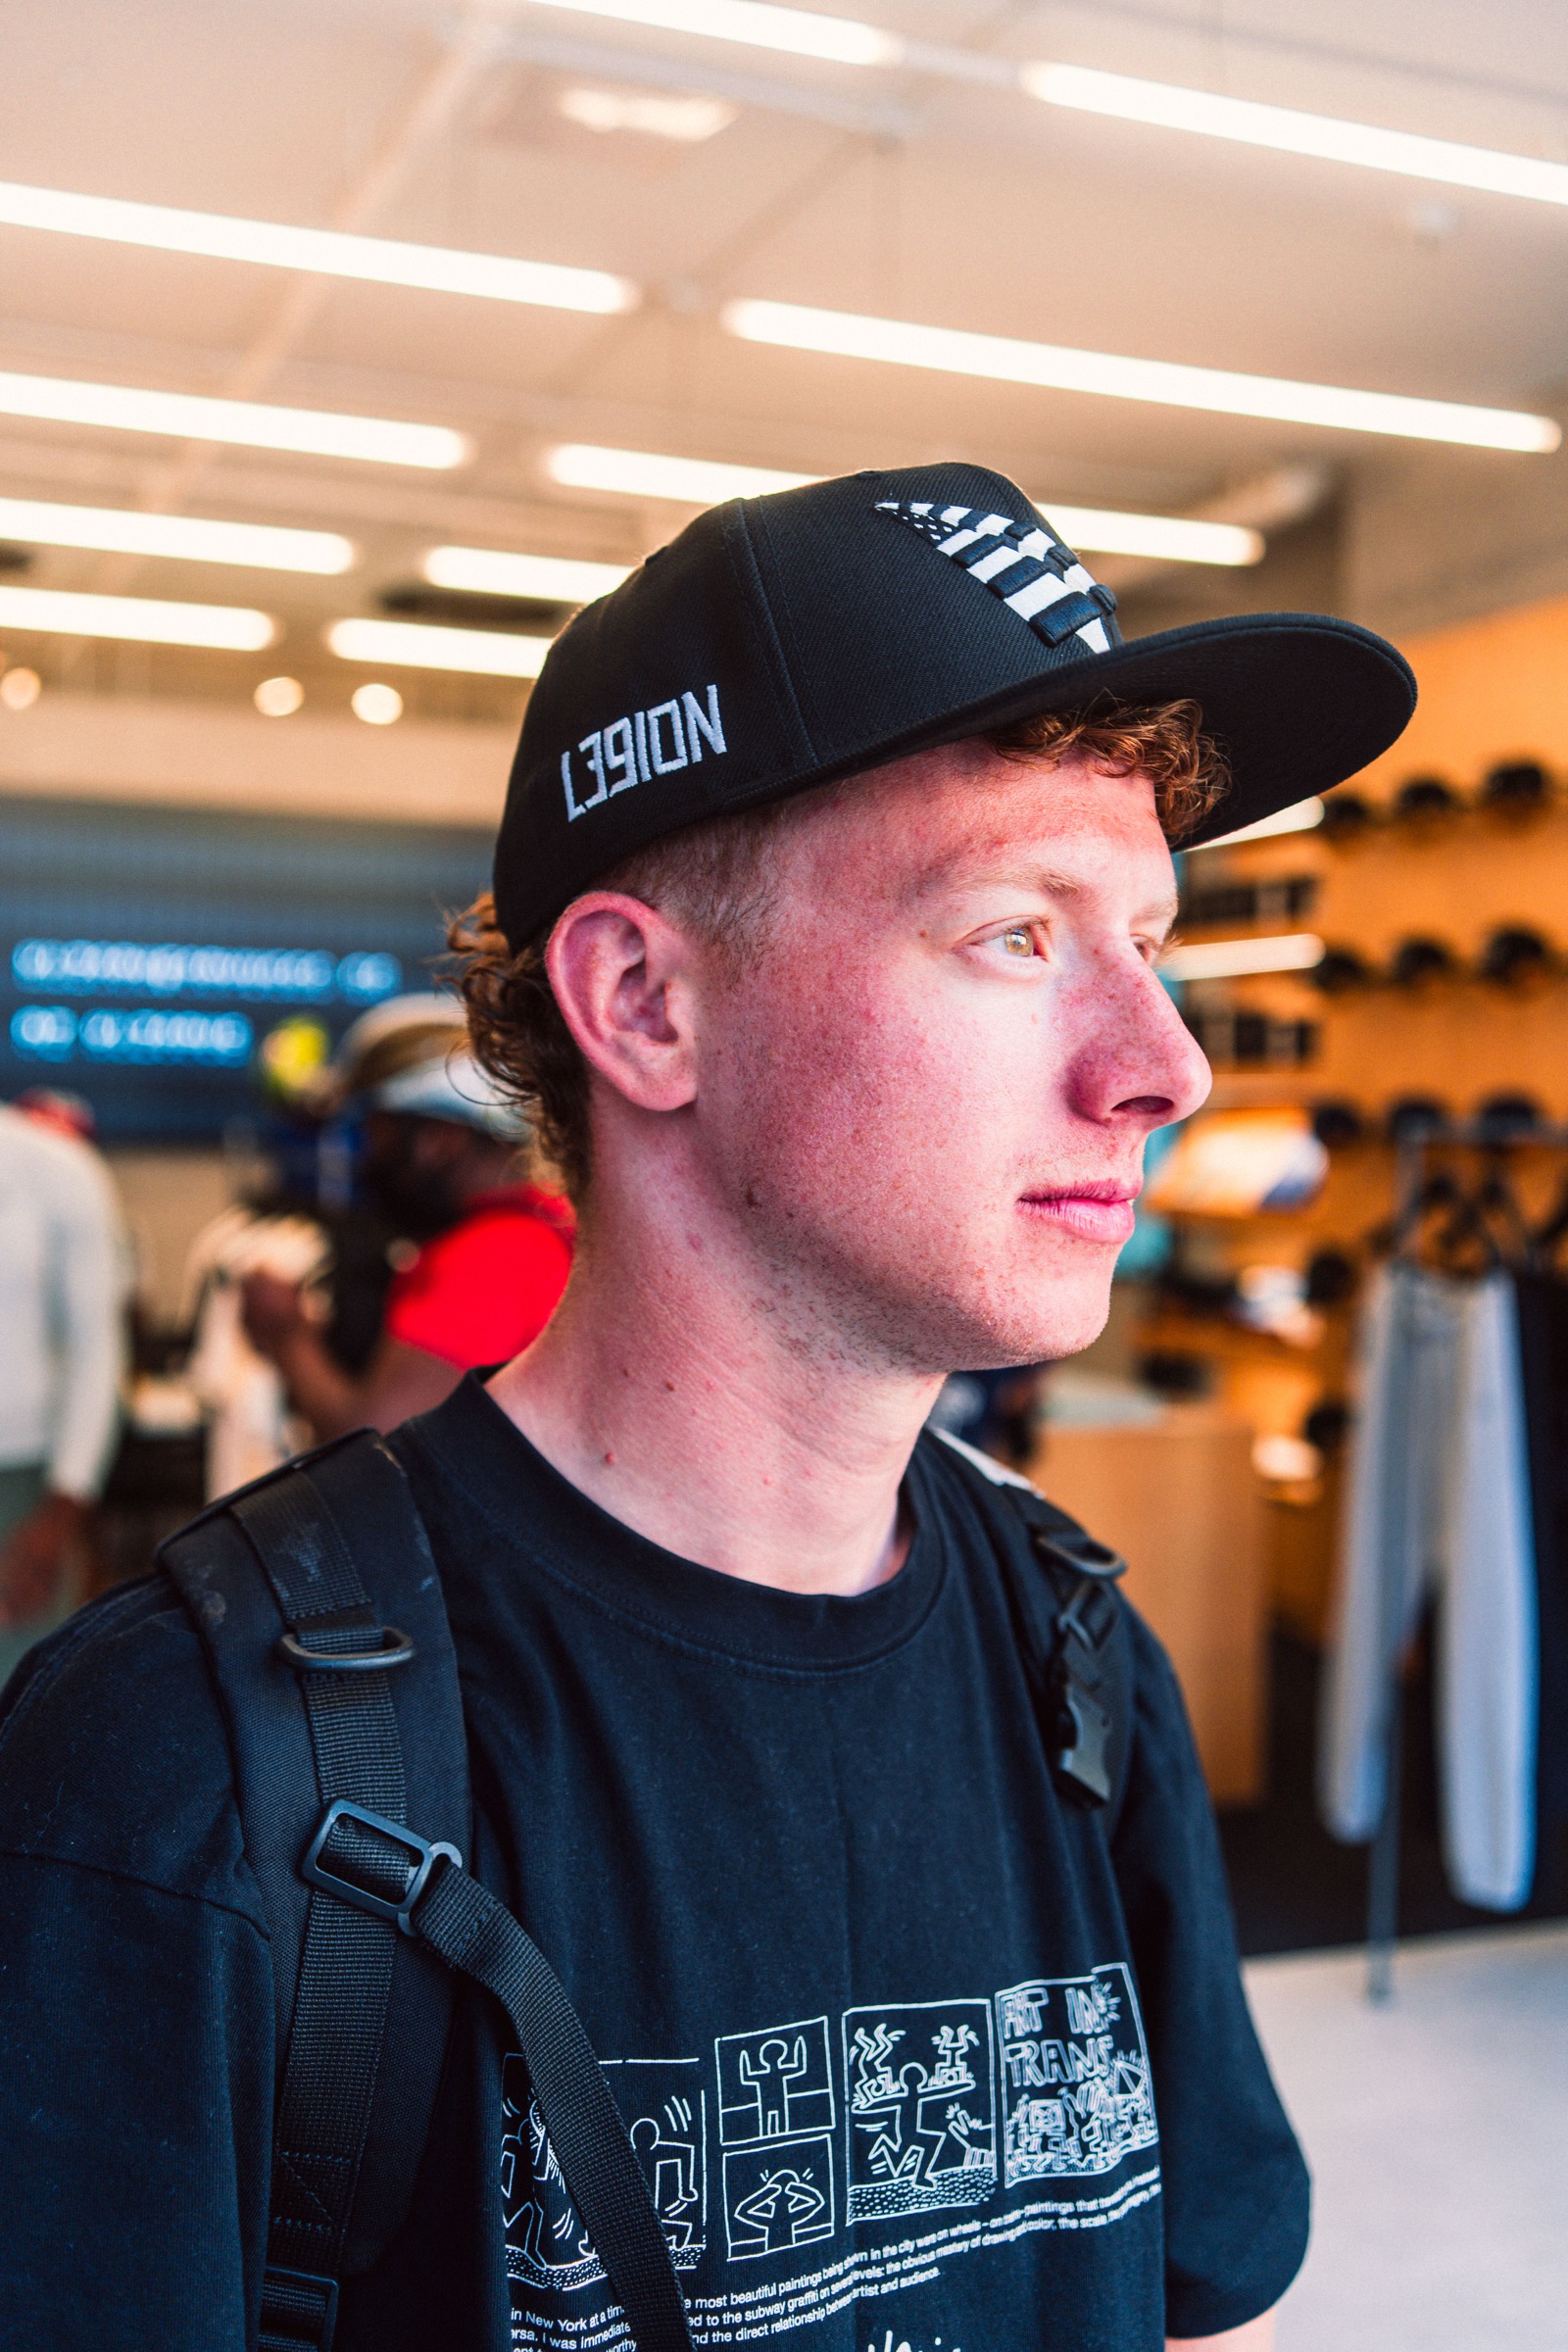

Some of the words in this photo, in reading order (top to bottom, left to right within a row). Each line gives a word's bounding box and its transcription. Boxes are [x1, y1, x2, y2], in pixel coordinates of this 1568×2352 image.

[511, 2307, 522, 2322] in
[525, 2310, 554, 2329] New
[557, 2317, 588, 2332] York
[589, 2313, 600, 2328] at
[600, 2311, 608, 2324] a
[607, 2305, 625, 2320] tim
[695, 2294, 727, 2309] most
[730, 2281, 777, 2306] beautiful
[778, 2271, 823, 2297] paintings
[822, 2262, 844, 2279] being
[870, 2247, 882, 2261] in
[882, 2243, 898, 2259] the
[898, 2238, 916, 2254] city
[542, 2331, 547, 2344] I
[549, 2336, 577, 2351] was
[580, 2321, 632, 2349] immediate
[706, 2314, 720, 2327] to
[722, 2311, 743, 2325] the
[745, 2300, 786, 2322] subway
[787, 2288, 819, 2313] graffiti
[819, 2286, 831, 2300] on
[886, 2261, 902, 2275] the
[902, 2250, 936, 2271] obvious
[1057, 2217, 1079, 2230] the
[711, 2330, 733, 2343] the
[735, 2323, 769, 2341] direct
[770, 2306, 826, 2334] relationship
[852, 2284, 880, 2299] artist
[880, 2277, 899, 2294] and
